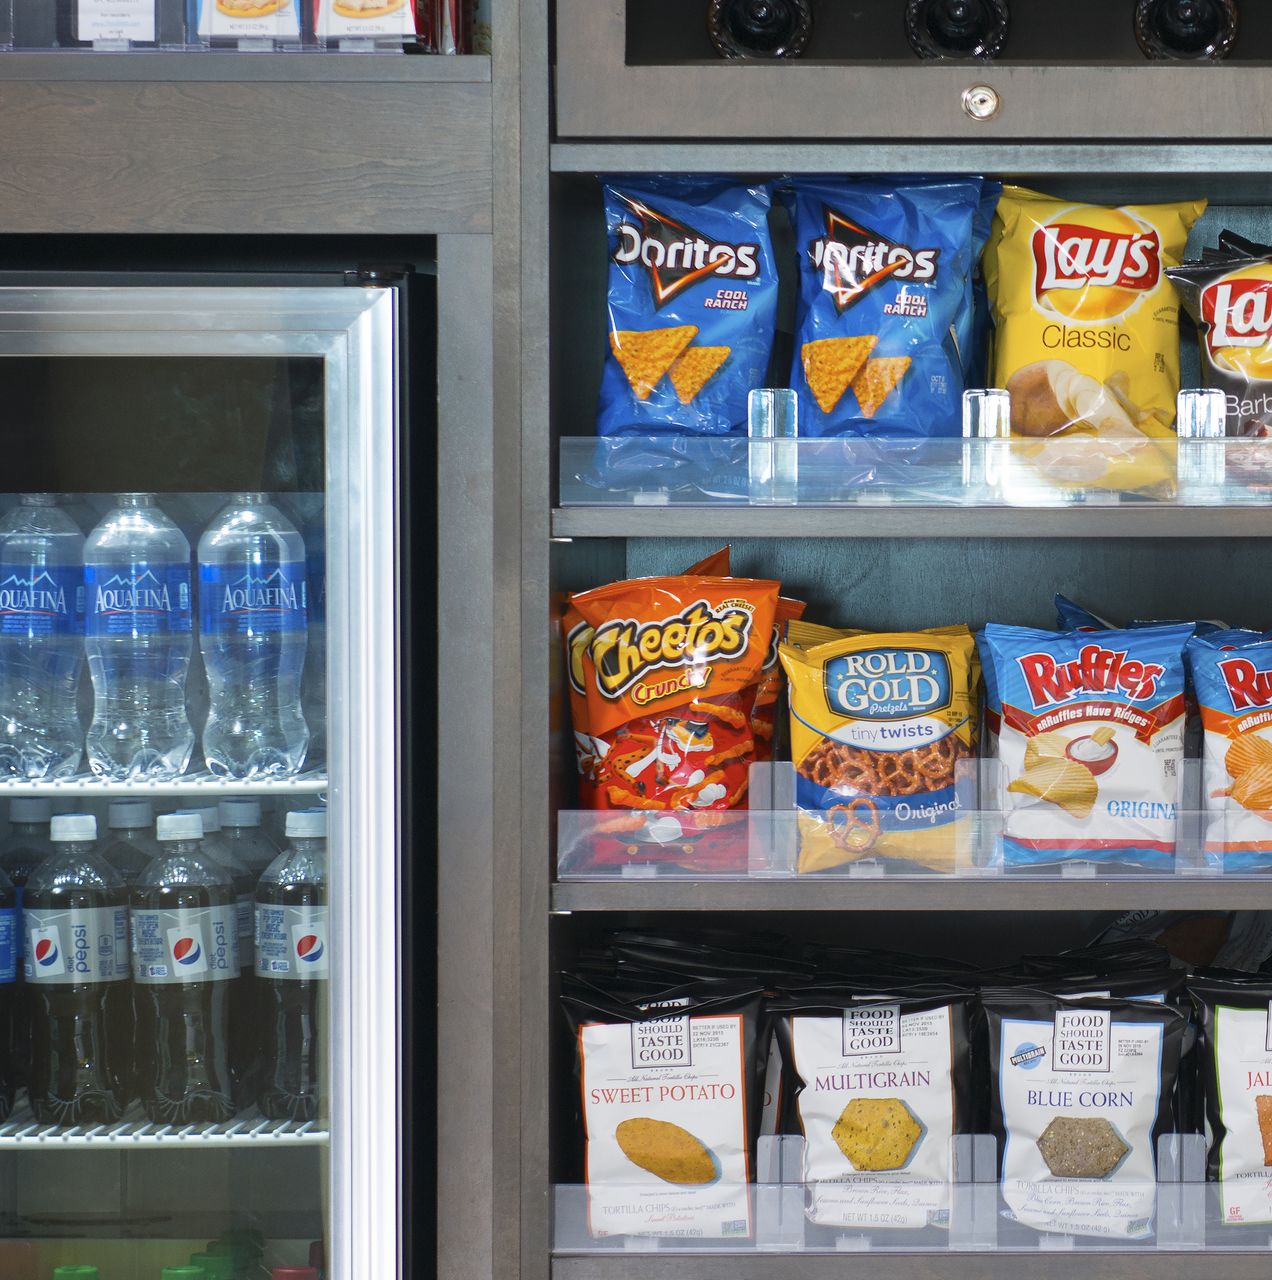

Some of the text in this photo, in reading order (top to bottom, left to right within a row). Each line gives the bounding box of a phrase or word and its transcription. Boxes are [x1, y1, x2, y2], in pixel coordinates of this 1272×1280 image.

[615, 225, 759, 279] Doritos
[1041, 227, 1156, 290] Lay's
[704, 298, 749, 310] RANCH
[716, 290, 749, 300] COOL
[1041, 325, 1132, 352] Classic
[95, 583, 173, 615] AQUAFINA
[221, 583, 299, 614] AQUAFINA
[592, 602, 746, 691] Cheetos
[845, 650, 932, 677] ROLD
[1018, 645, 1166, 709] Ruffles
[837, 675, 940, 714] GOLD
[1086, 704, 1111, 718] Have
[1113, 707, 1150, 729] Ridges
[850, 723, 934, 742] tiny twists
[894, 797, 962, 824] Original
[72, 923, 91, 974] pepsi
[213, 920, 229, 971] pepsi
[850, 1010, 894, 1020] FOOD
[638, 1024, 683, 1034] SHOULD
[848, 1027, 894, 1037] TASTE
[1060, 1029, 1104, 1039] SHOULD
[637, 1035, 684, 1048] TASTE
[850, 1036, 894, 1050] GOOD
[1059, 1039, 1103, 1051] TASTE
[639, 1048, 684, 1062] GOOD
[1059, 1053, 1103, 1066] GOOD
[815, 1070, 932, 1092] MULTIGRAIN
[590, 1083, 736, 1105] SWEET POTATO
[1027, 1090, 1134, 1107] BLUE CORN
[602, 1203, 671, 1216] TORTILLA CHIPS
